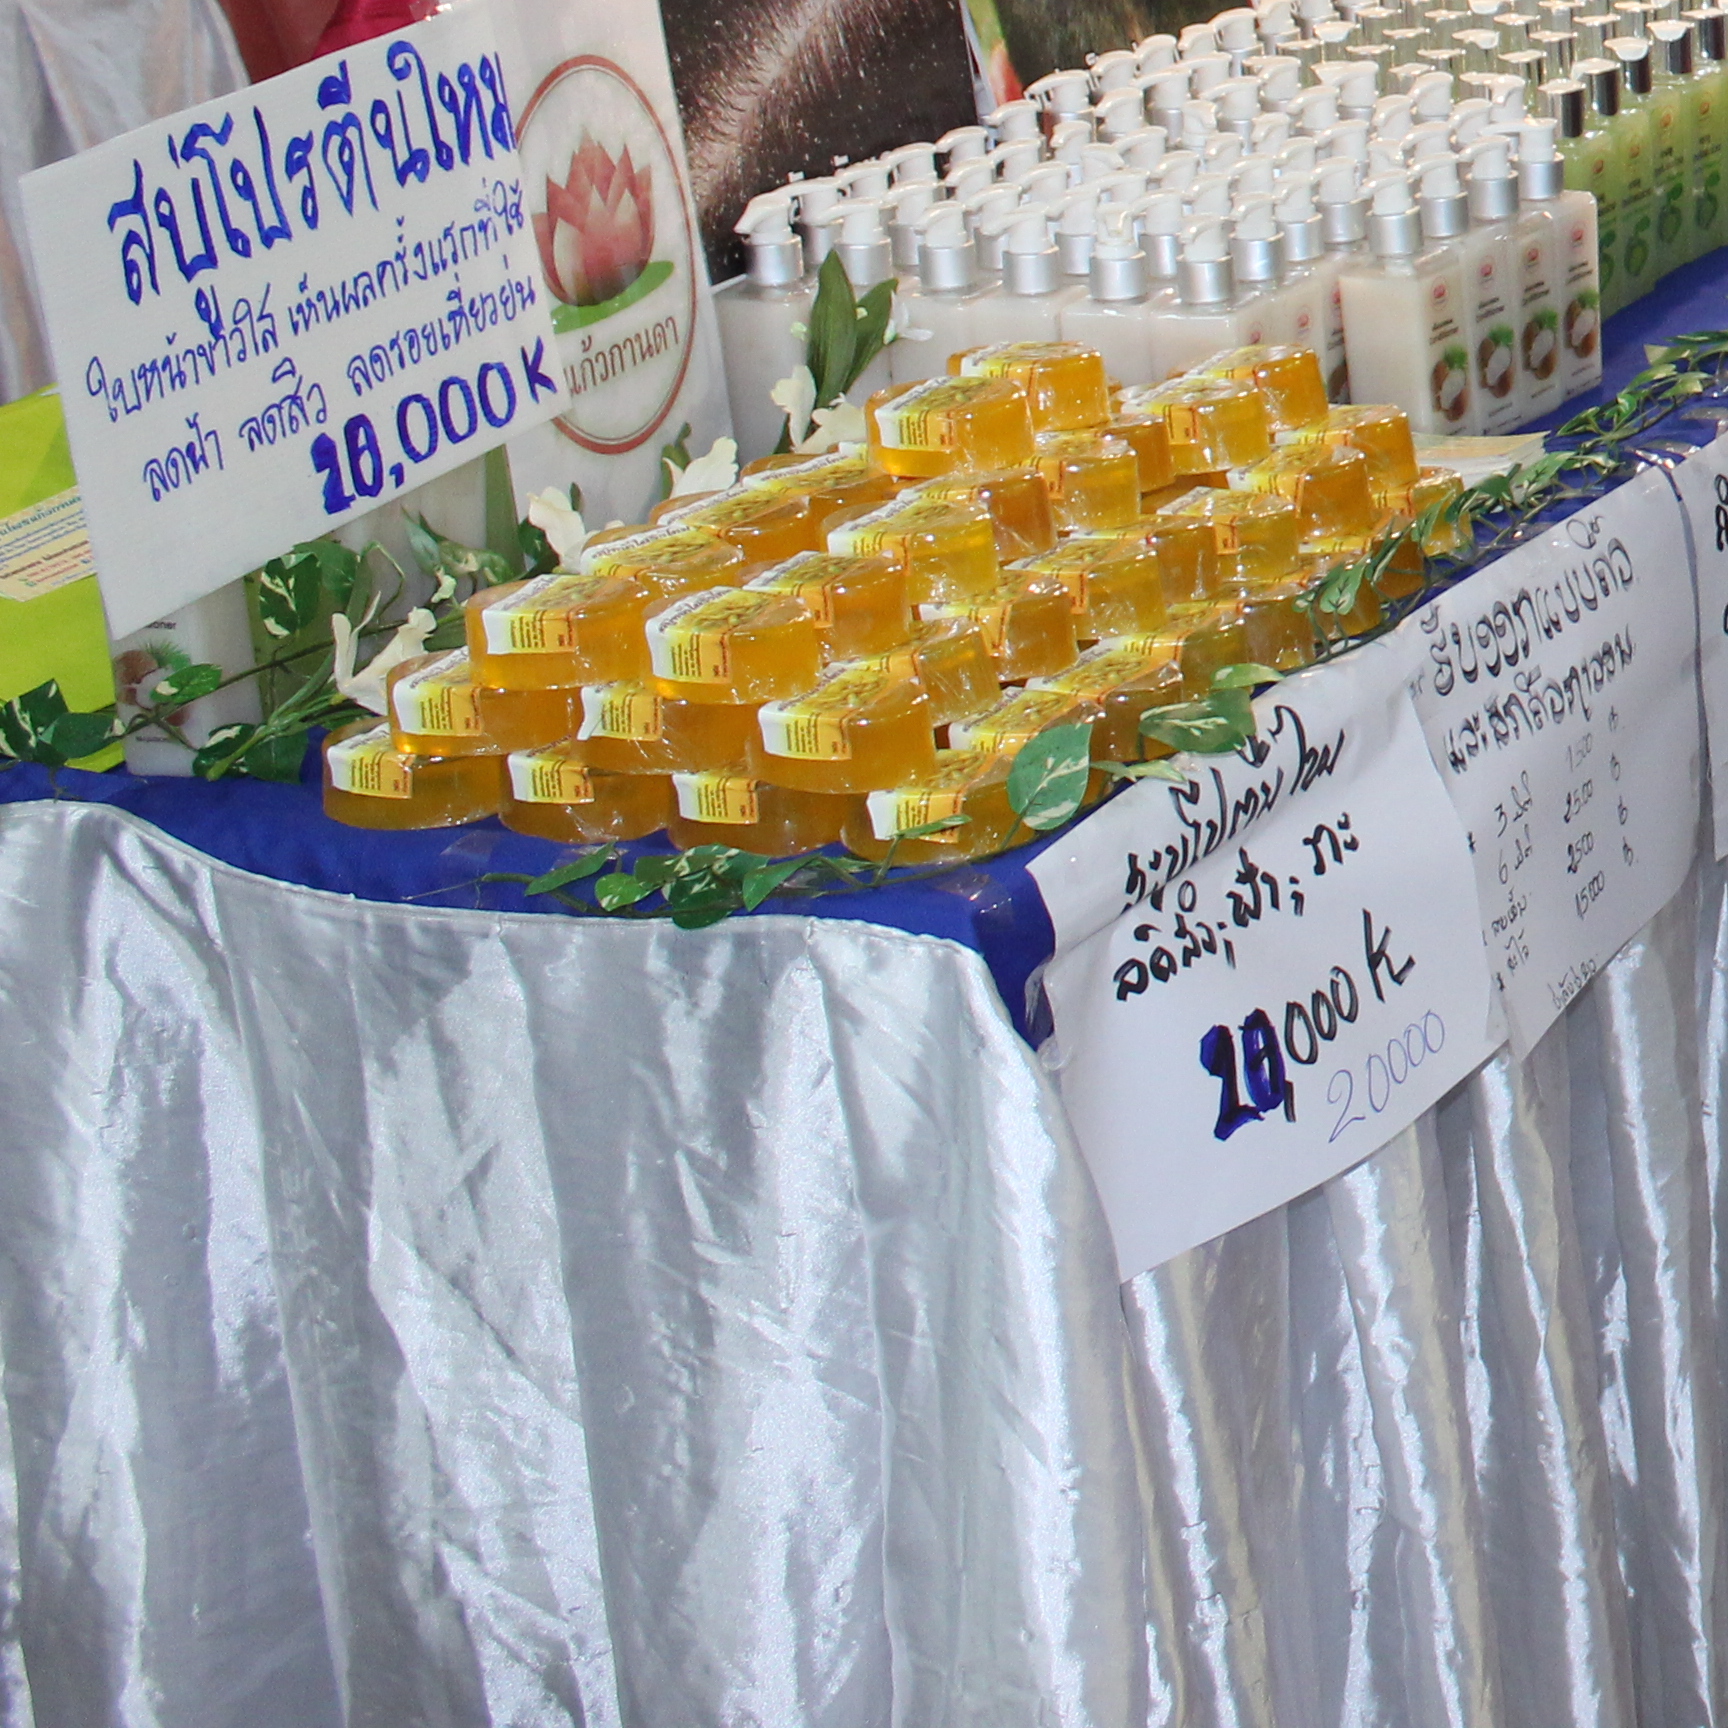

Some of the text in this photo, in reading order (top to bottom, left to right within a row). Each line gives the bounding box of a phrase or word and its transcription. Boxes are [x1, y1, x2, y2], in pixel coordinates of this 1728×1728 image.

[563, 315, 679, 399] แก้วกานดา
[1326, 1008, 1448, 1145] 20000
